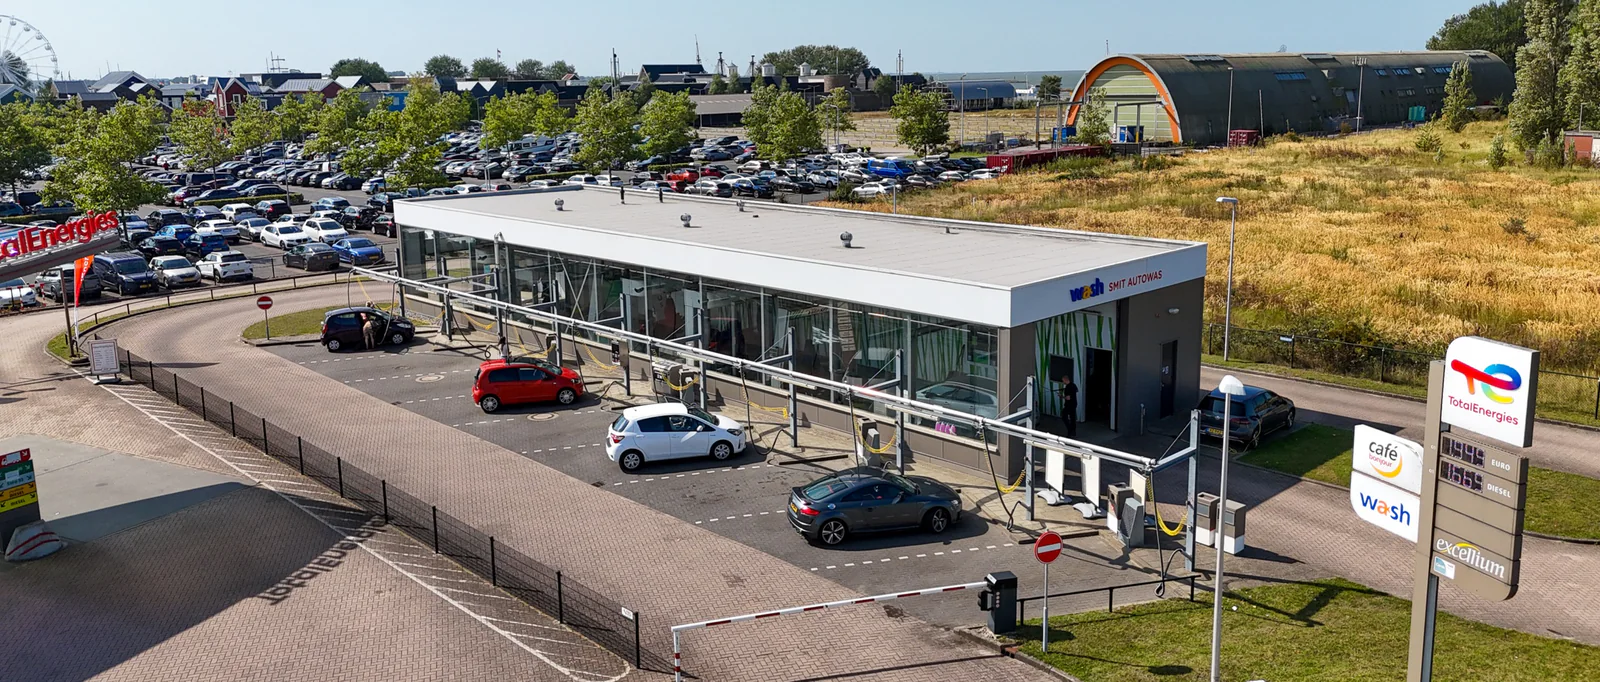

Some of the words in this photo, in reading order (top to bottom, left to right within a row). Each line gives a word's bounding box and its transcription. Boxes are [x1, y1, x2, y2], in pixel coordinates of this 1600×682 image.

[0, 210, 119, 259] alEnergies
[1069, 277, 1105, 302] wash
[1108, 278, 1126, 292] SMIT
[1127, 270, 1163, 287] AUTOWAS
[1448, 395, 1519, 426] TotalEnergies
[1368, 441, 1398, 461] café
[1368, 453, 1393, 468] bonjour
[1491, 459, 1511, 471] EURO
[1487, 483, 1511, 498] DIESEL
[1359, 491, 1411, 526] wash
[1436, 538, 1505, 579] excellium
